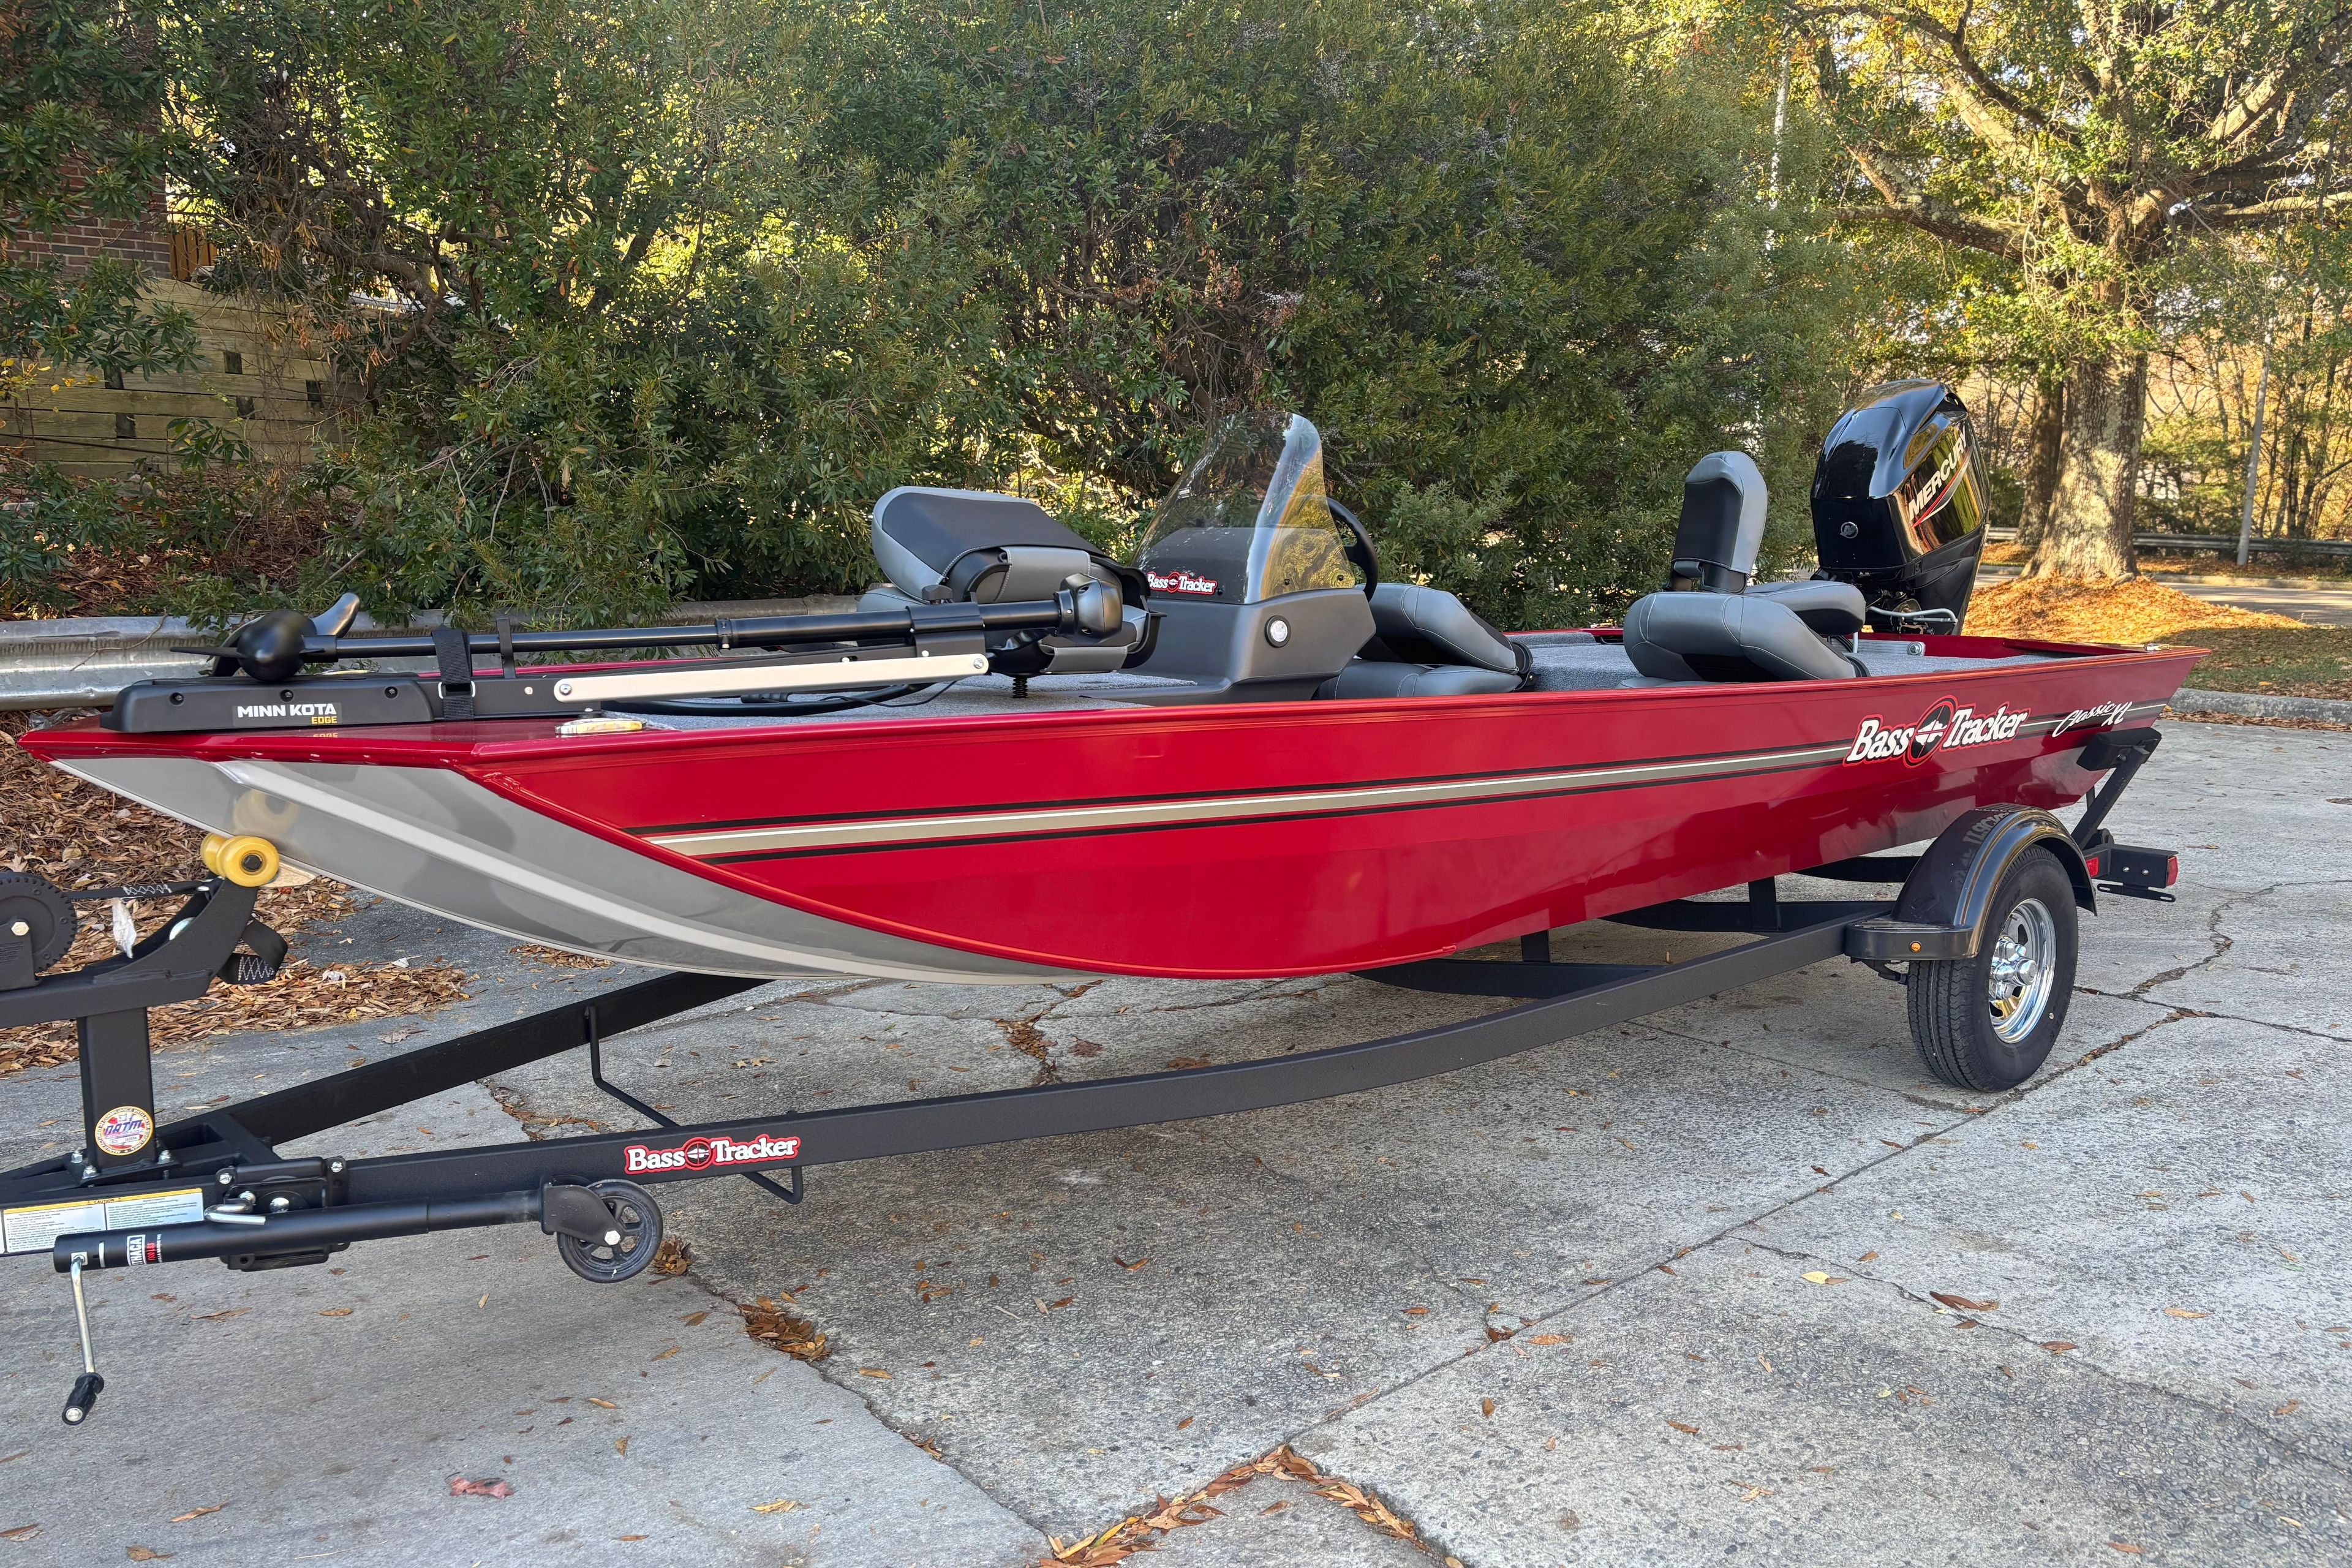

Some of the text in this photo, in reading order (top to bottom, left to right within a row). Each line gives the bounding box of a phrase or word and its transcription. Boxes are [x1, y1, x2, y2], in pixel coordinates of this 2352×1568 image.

[1909, 424, 1967, 521] MERCURY
[1147, 573, 1215, 592] Bass Tracker
[237, 703, 337, 718] MINN KOTA
[311, 715, 337, 725] EDGE
[2052, 700, 2116, 737] Classic
[1846, 706, 2028, 762] Bass Tracker
[628, 1137, 798, 1171] Bass Tracker
[129, 1238, 145, 1266] ITHACA
